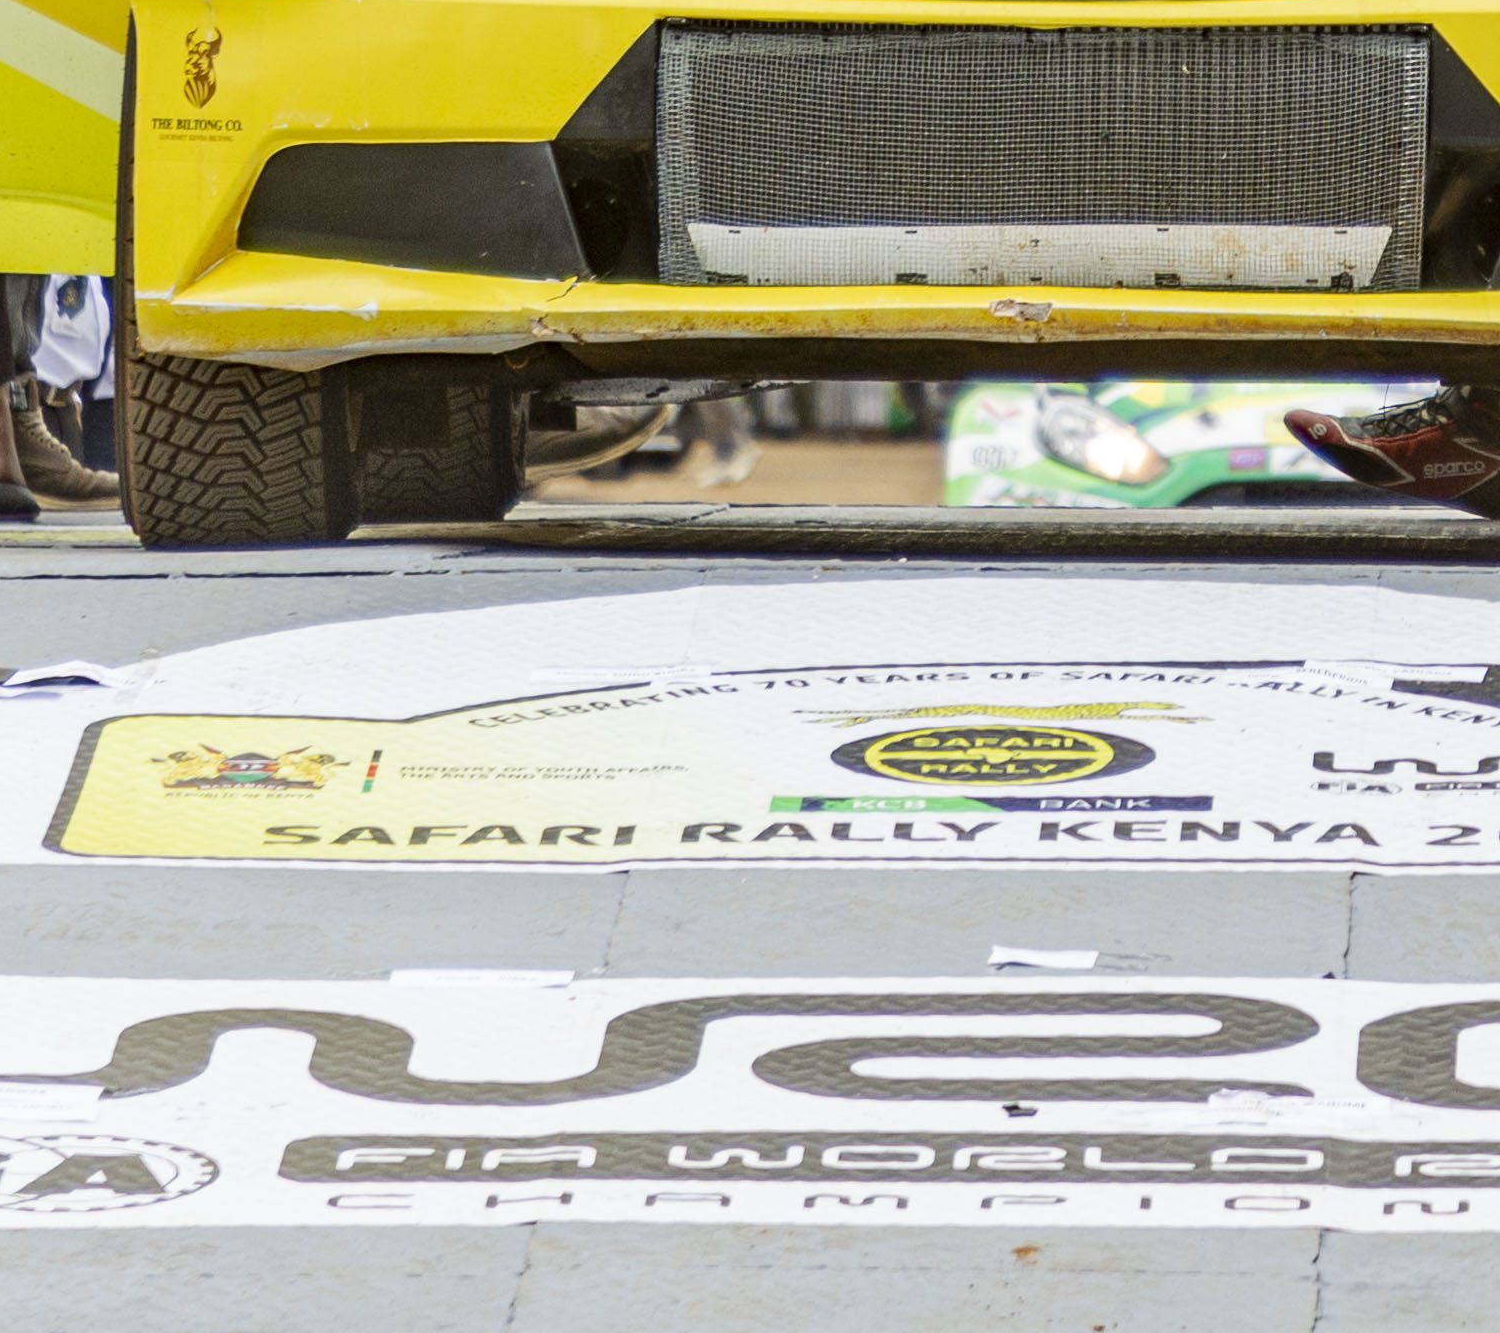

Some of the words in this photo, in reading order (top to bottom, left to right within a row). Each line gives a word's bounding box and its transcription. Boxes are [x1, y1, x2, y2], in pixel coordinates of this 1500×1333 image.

[152, 118, 172, 129] THE
[176, 119, 222, 131] BILTONG
[1424, 461, 1486, 479] sparco
[468, 682, 739, 728] CELEBRATING
[757, 679, 817, 691] 70
[824, 671, 969, 686] YEARS
[990, 671, 1046, 682] OF
[1243, 679, 1365, 698] ALLY
[913, 737, 1073, 748] SAFARI
[921, 762, 1058, 775] RALLY
[853, 800, 926, 809] KCB
[1041, 797, 1153, 809] BANK
[264, 825, 636, 845] SAFARI
[681, 822, 998, 842] RALLY
[1039, 821, 1380, 846] KENYA
[336, 1146, 597, 1170] FIA
[668, 1145, 1324, 1171] WORLD
